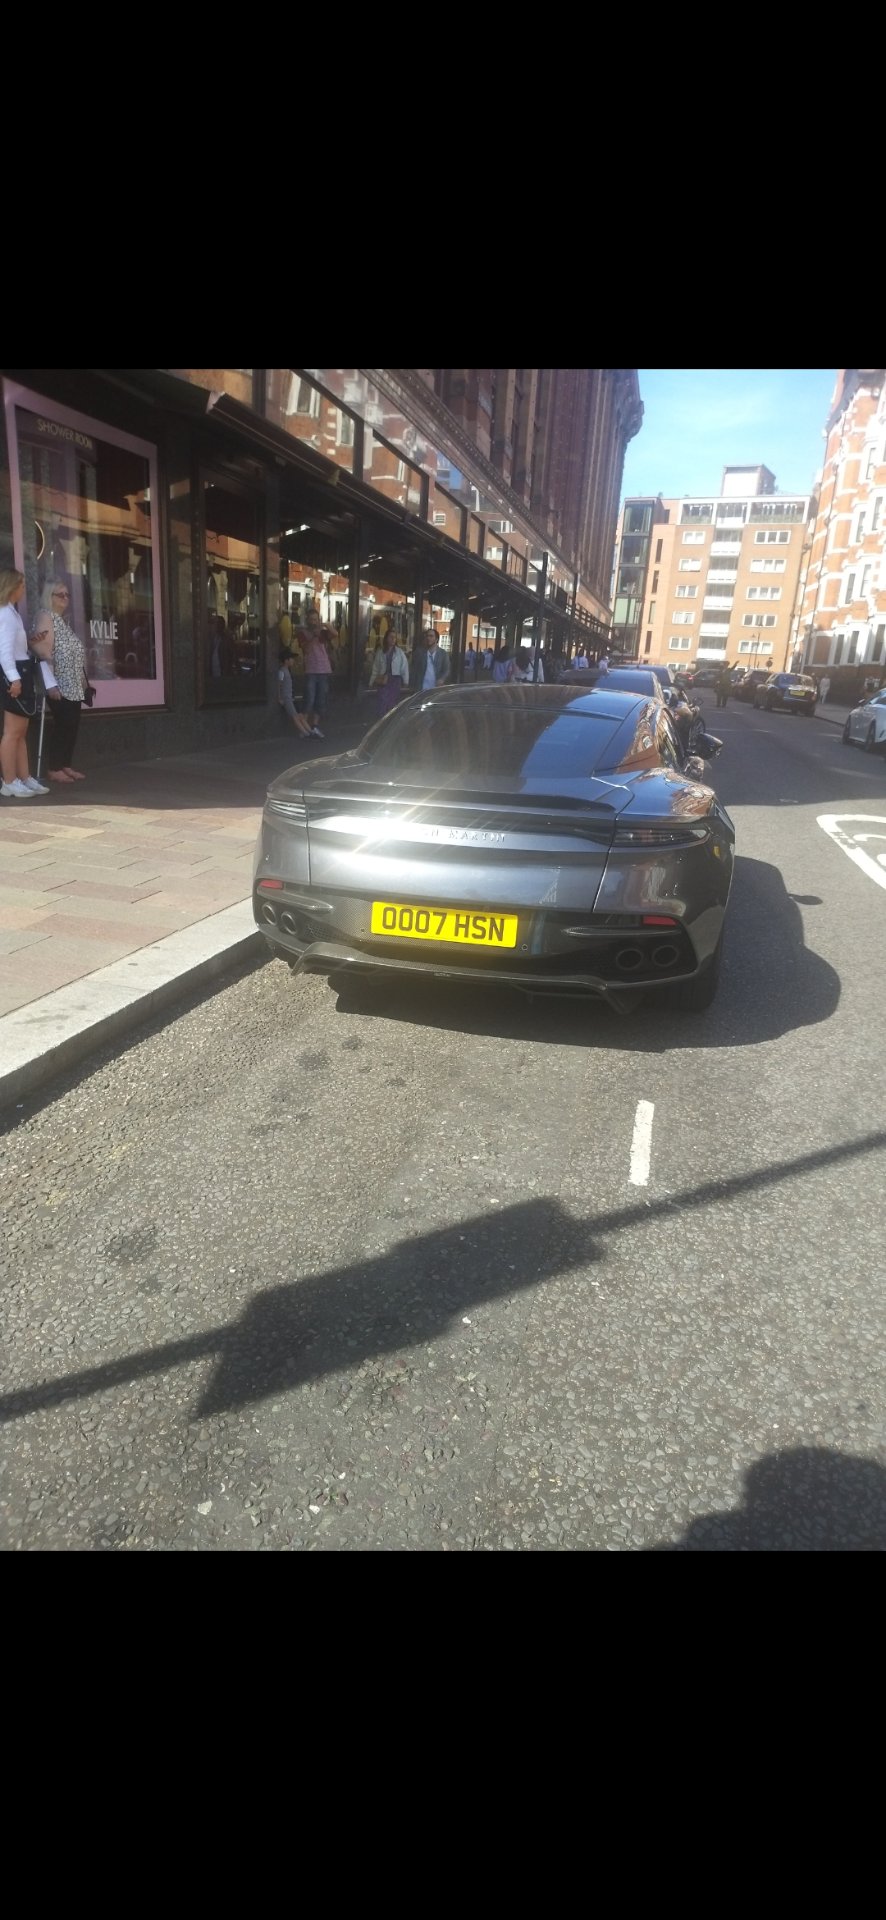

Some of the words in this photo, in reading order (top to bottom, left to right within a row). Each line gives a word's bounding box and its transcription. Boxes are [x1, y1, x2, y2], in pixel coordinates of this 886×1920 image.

[37, 418, 73, 441] SHOWER
[90, 620, 119, 640] KYLIE
[454, 913, 505, 941] HSN
